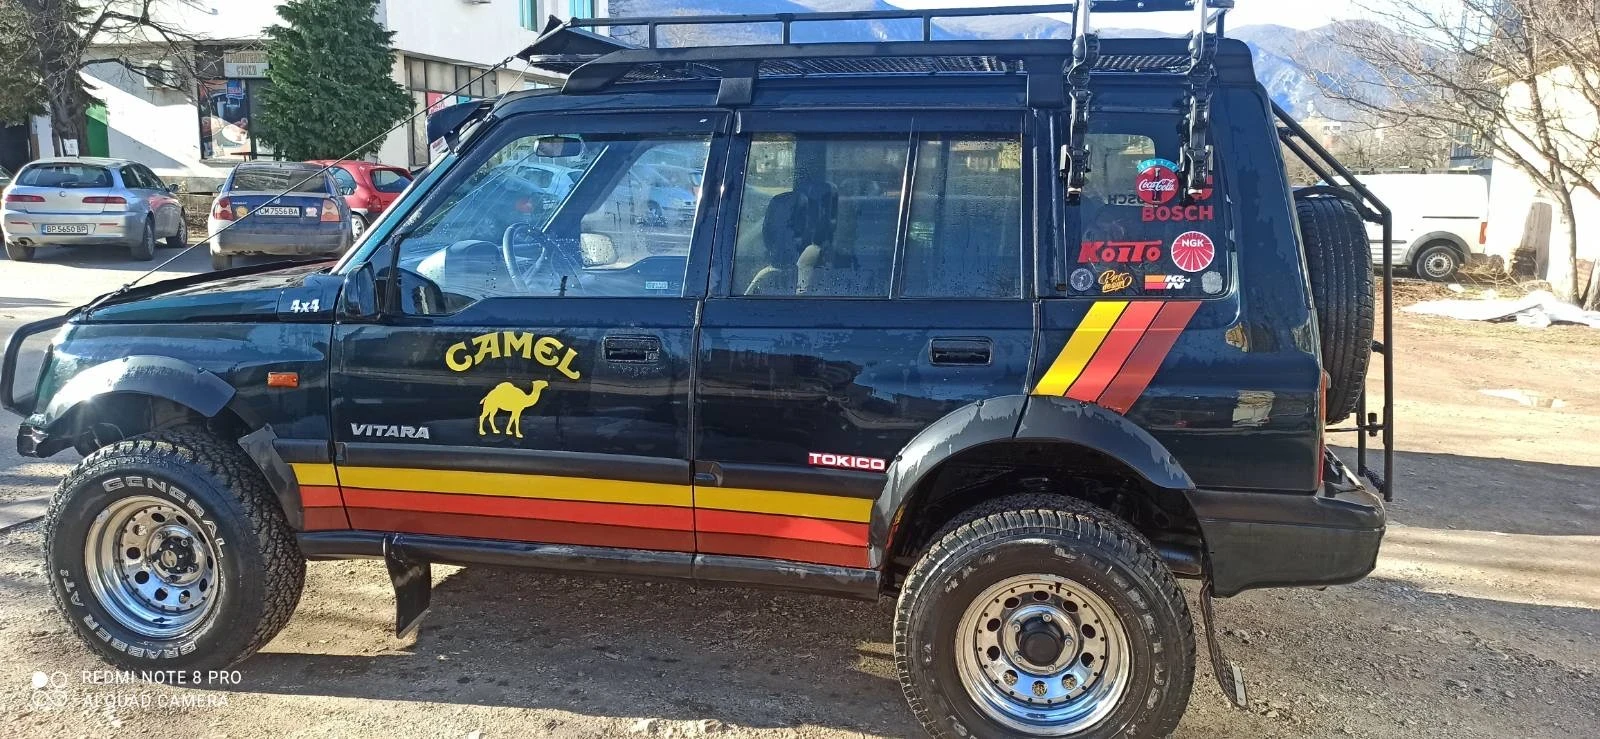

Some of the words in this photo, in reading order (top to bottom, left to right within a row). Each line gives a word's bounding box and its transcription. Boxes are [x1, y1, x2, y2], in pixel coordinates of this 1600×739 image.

[1142, 205, 1213, 222] BOSCH
[1181, 239, 1204, 247] NGK
[291, 299, 320, 313] 4x4
[445, 331, 581, 380] CAMEL
[350, 422, 430, 440] VITARA
[808, 452, 886, 470] TOKICO
[102, 475, 226, 558] GENERAL
[84, 614, 197, 659] GRABBER
